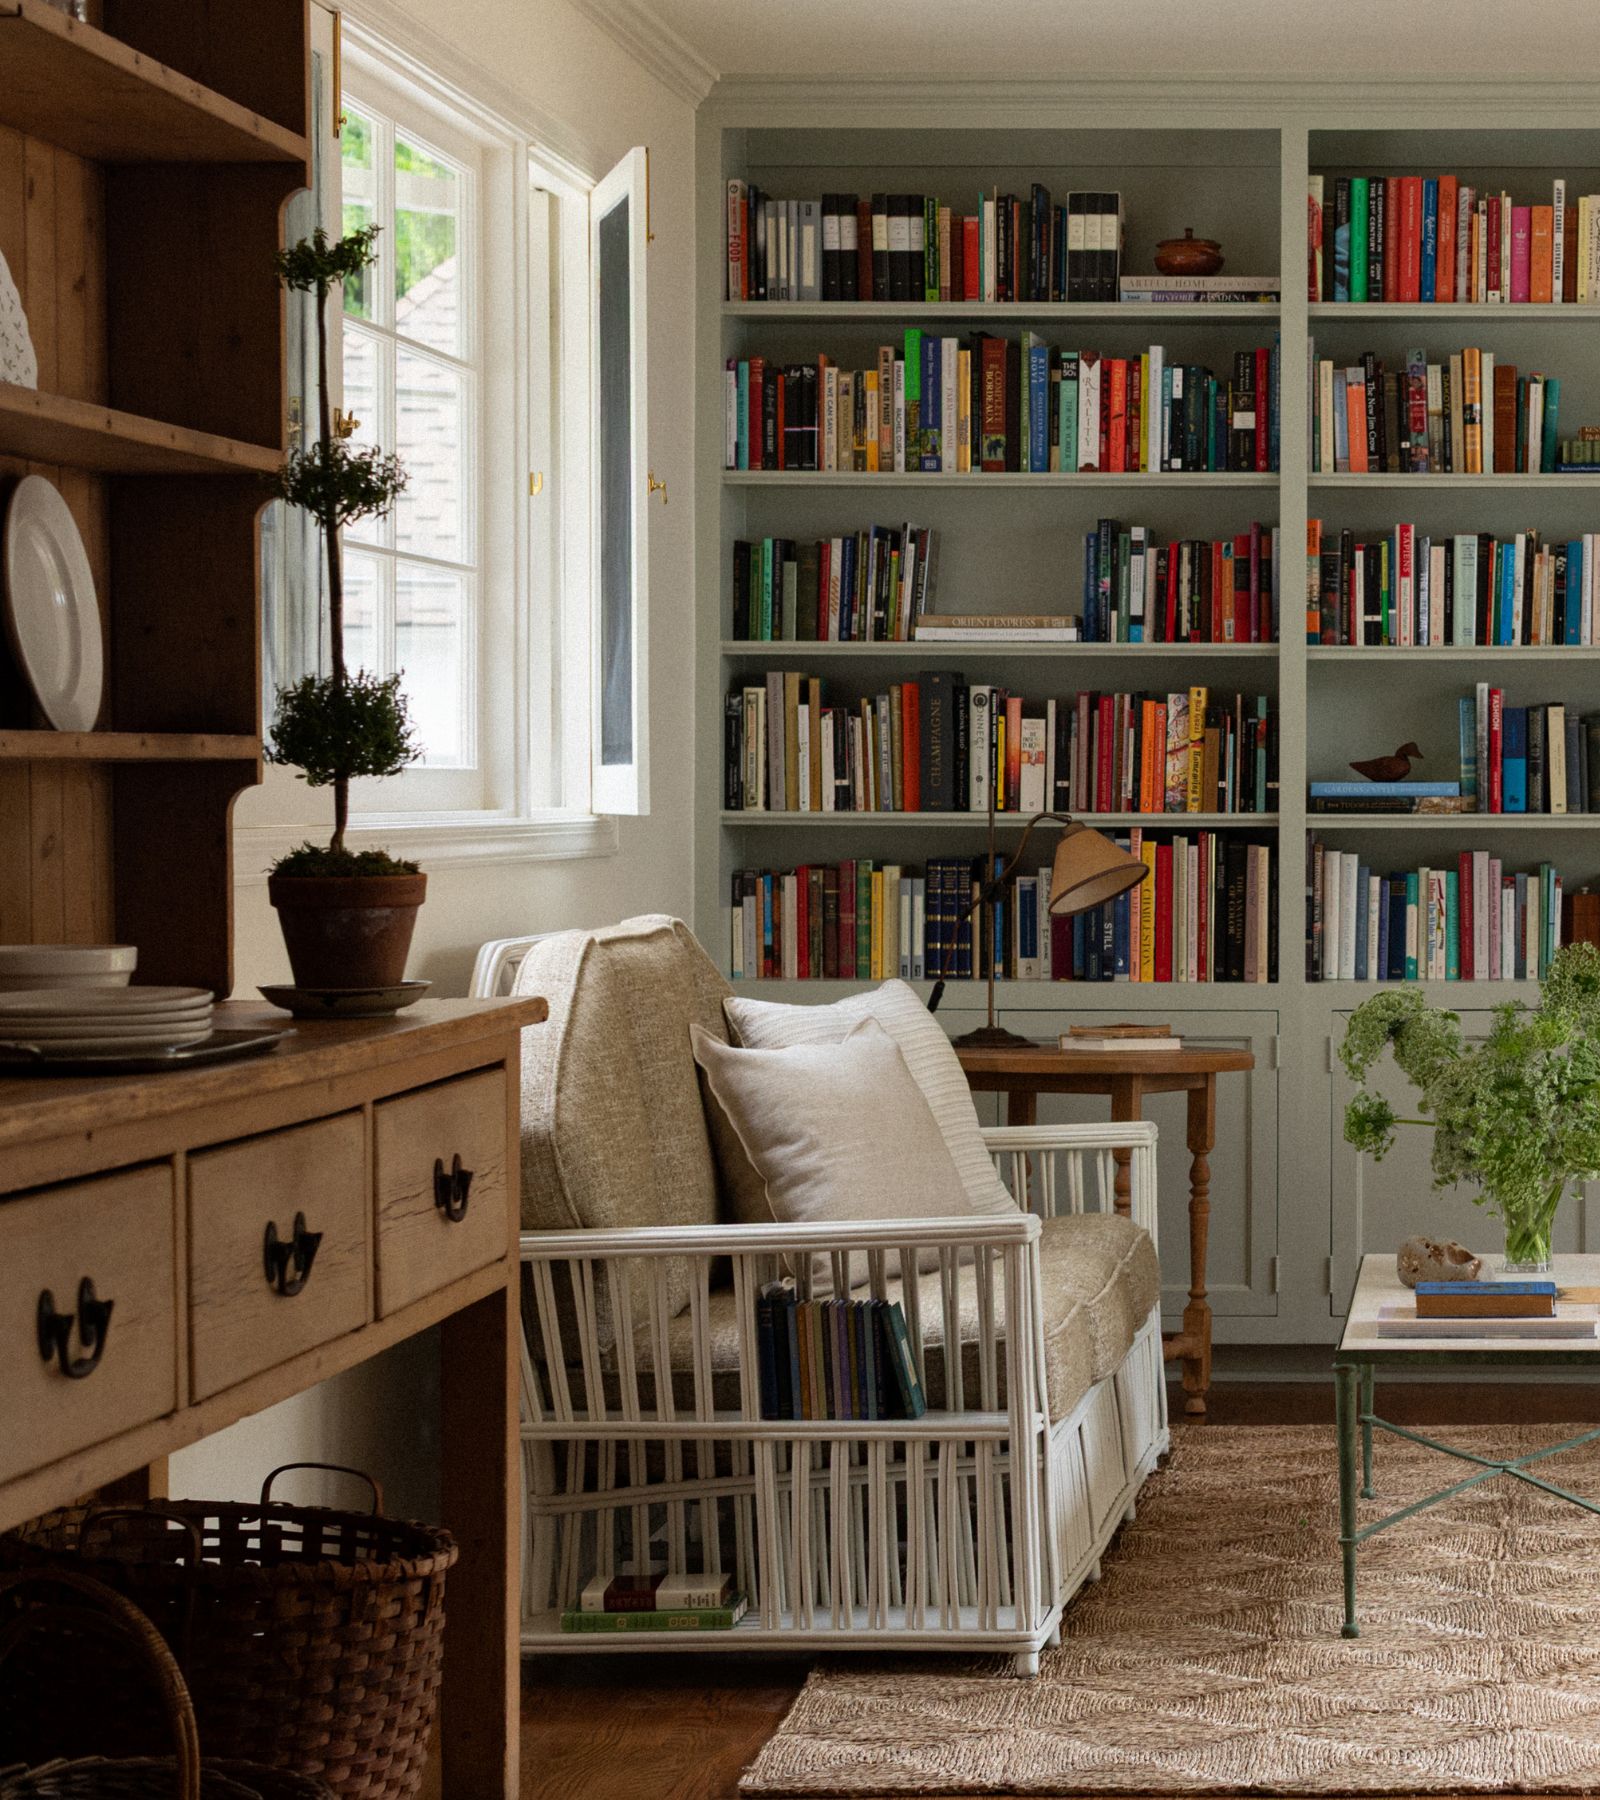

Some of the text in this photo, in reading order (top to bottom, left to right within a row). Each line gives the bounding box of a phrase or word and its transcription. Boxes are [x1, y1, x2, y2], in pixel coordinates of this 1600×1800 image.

[1459, 192, 1467, 252] ANNE FRANK
[1556, 205, 1563, 213] LE
[731, 234, 741, 263] FOOD
[1377, 243, 1383, 253] IN
[1425, 215, 1435, 256] Robert Frost
[1200, 293, 1247, 302] PASADENA
[882, 350, 891, 364] HOW
[926, 341, 935, 362] Monty
[1062, 361, 1077, 369] THE
[882, 365, 891, 377] THE
[1038, 357, 1046, 384] RITA
[827, 386, 834, 398] WE
[882, 378, 891, 394] WORD
[946, 386, 954, 411] FARM
[985, 370, 994, 424] BORDEAUX
[994, 370, 1004, 424] COMPLETE
[1443, 373, 1451, 416] DAKOTA
[882, 403, 891, 426] PASSED
[1367, 381, 1377, 453] The New Jim Crow
[1403, 531, 1412, 573] SAPIENS
[951, 616, 1037, 627] ORIENT EXPRESS
[1492, 694, 1500, 731] FASHION
[931, 698, 942, 788] CHAMPAGNE
[1191, 750, 1201, 795] Homegoing
[1228, 884, 1236, 935] OF COLOR
[1427, 878, 1437, 962] Didion The White Album
[1104, 921, 1113, 951] STILL
[1143, 888, 1152, 967] CHARLESTON
